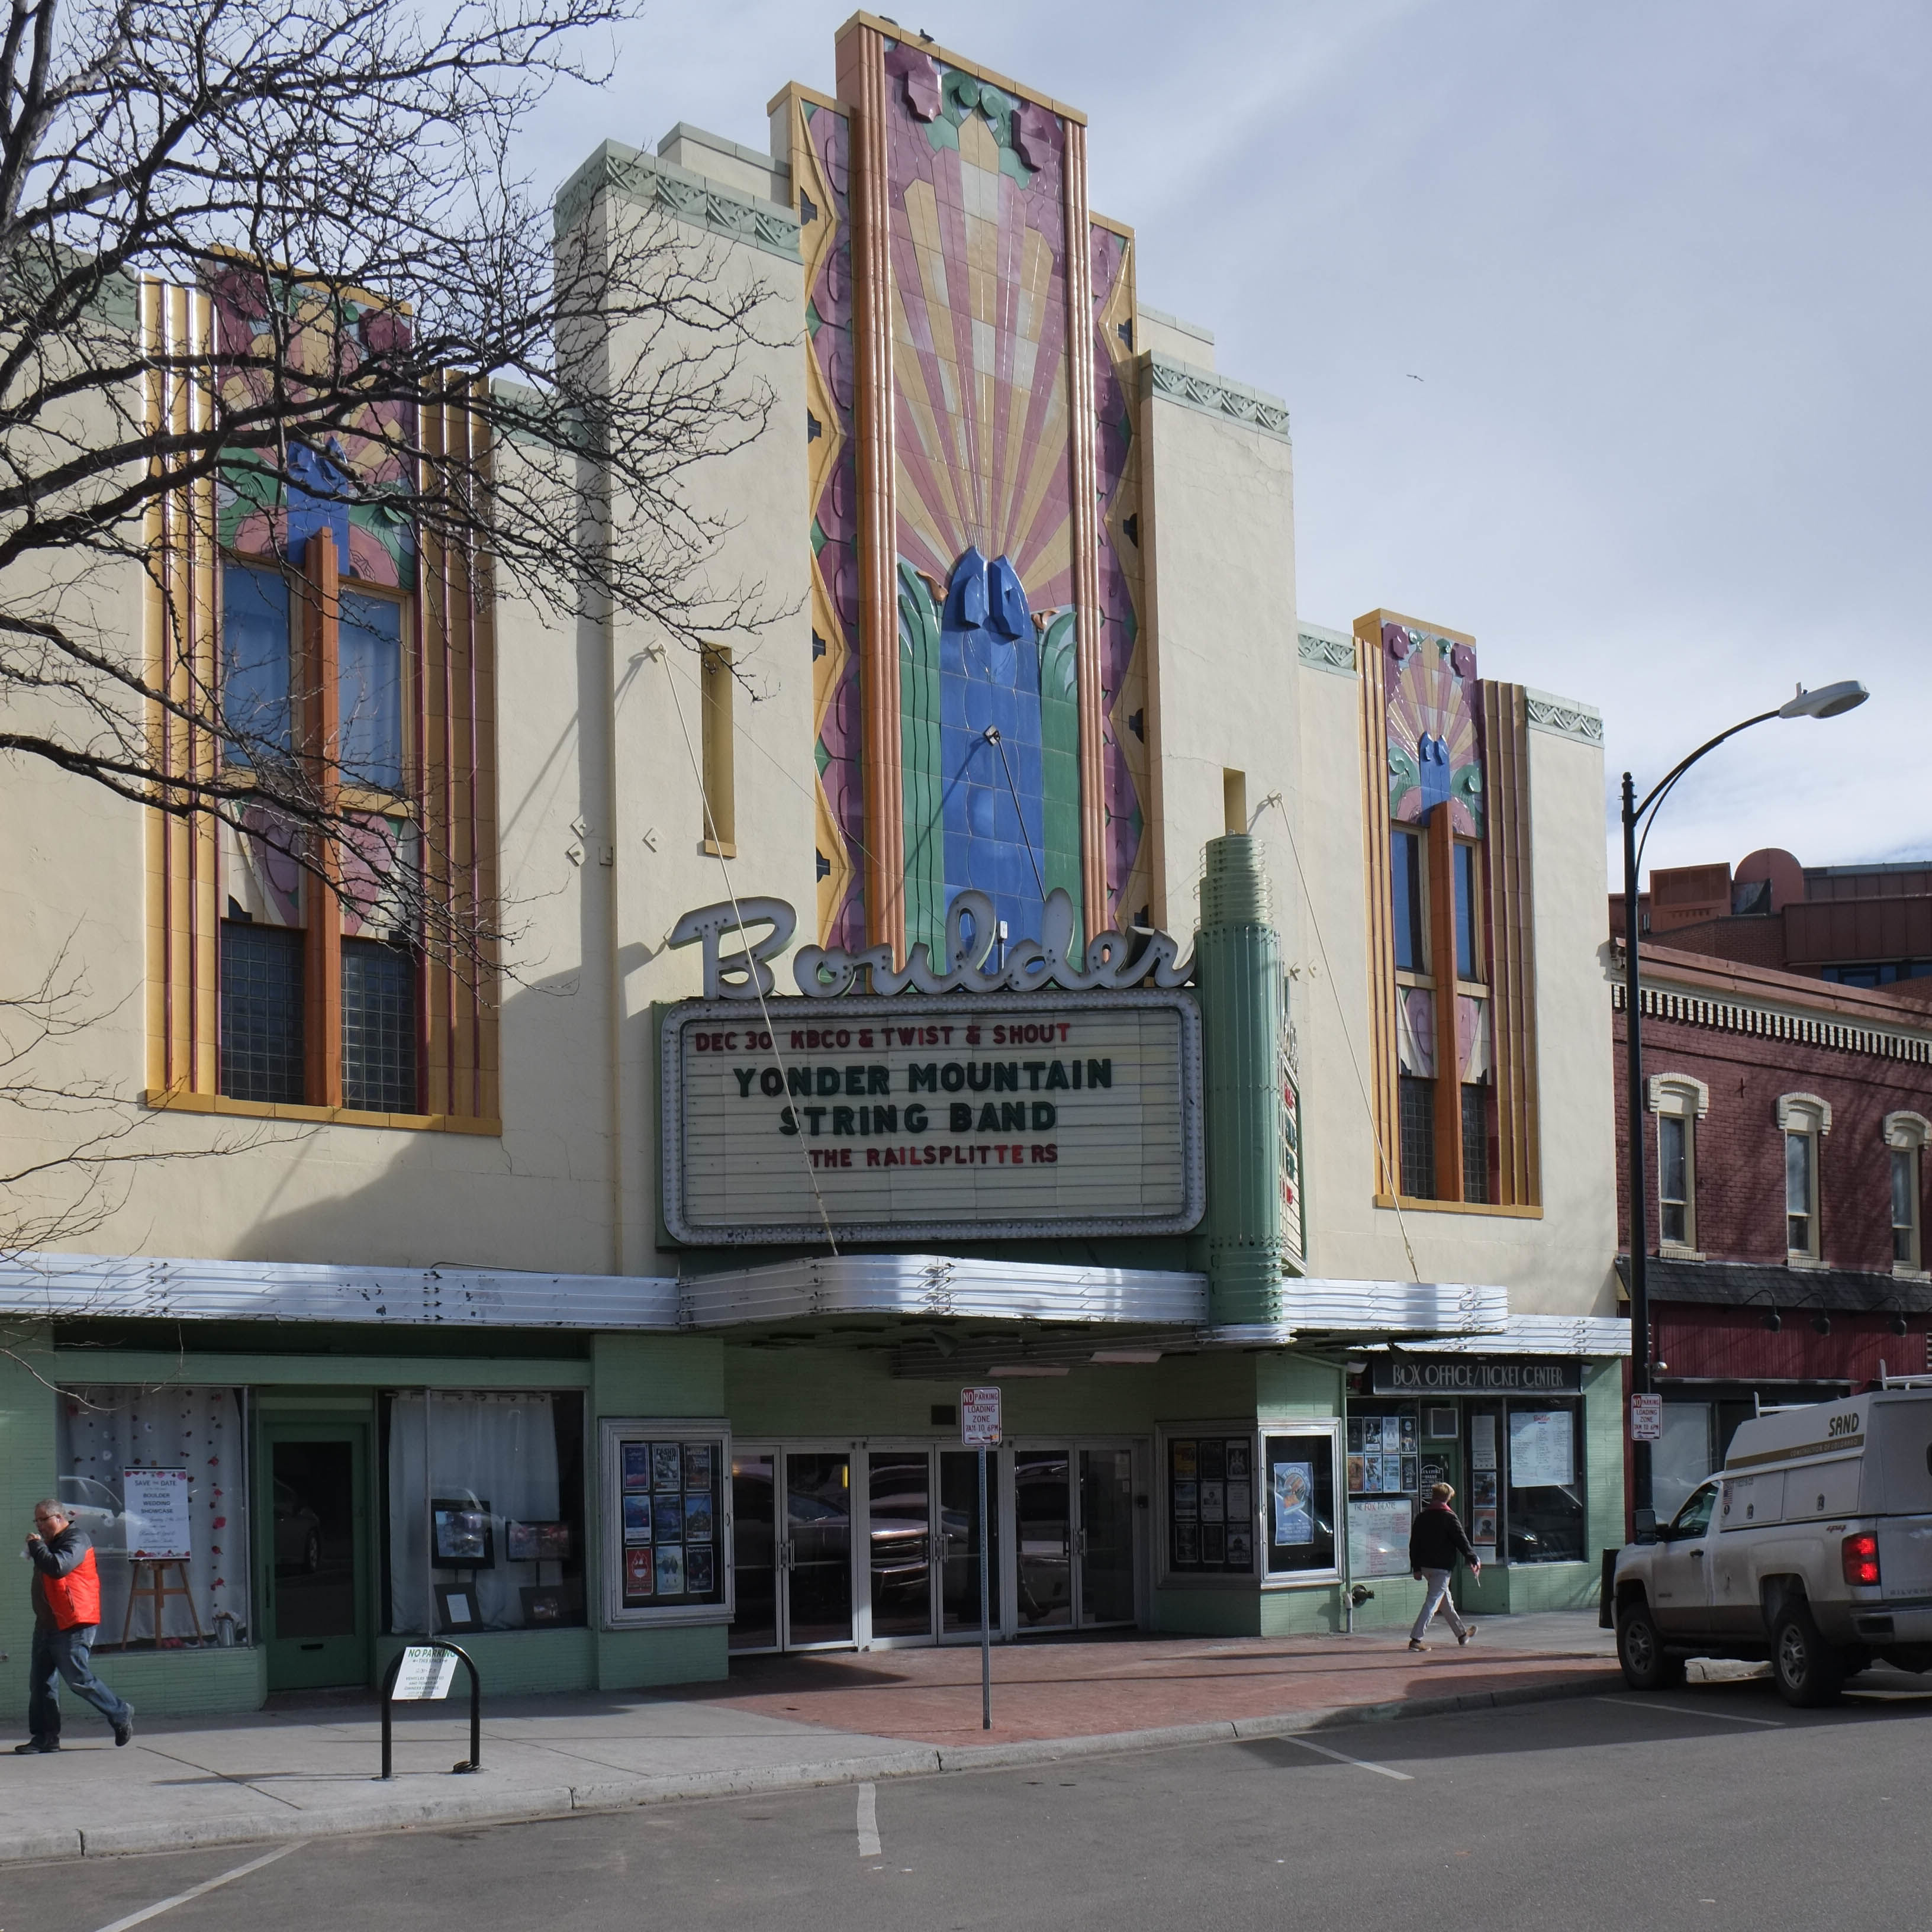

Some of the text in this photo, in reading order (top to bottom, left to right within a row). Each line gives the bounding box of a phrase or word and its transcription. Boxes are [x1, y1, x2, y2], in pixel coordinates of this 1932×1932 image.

[668, 887, 1196, 1000] Boulder
[695, 1022, 1071, 1052] DEC 30 KBCO & TWIST & SHOUT
[733, 1058, 1112, 1098] YONDER MOUNTAIN
[779, 1100, 1057, 1135] STRING BAND
[809, 1148, 852, 1168] THE
[1393, 1364, 1422, 1386] BOX
[1523, 1366, 1564, 1387] CENTER
[963, 1392, 973, 1403] NO
[1634, 1397, 1641, 1407] NO
[968, 1405, 995, 1413] LOADING
[1828, 1412, 1859, 1437] SAND
[1364, 1502, 1376, 1511] FOX
[408, 1648, 456, 1658] NO PARKING
